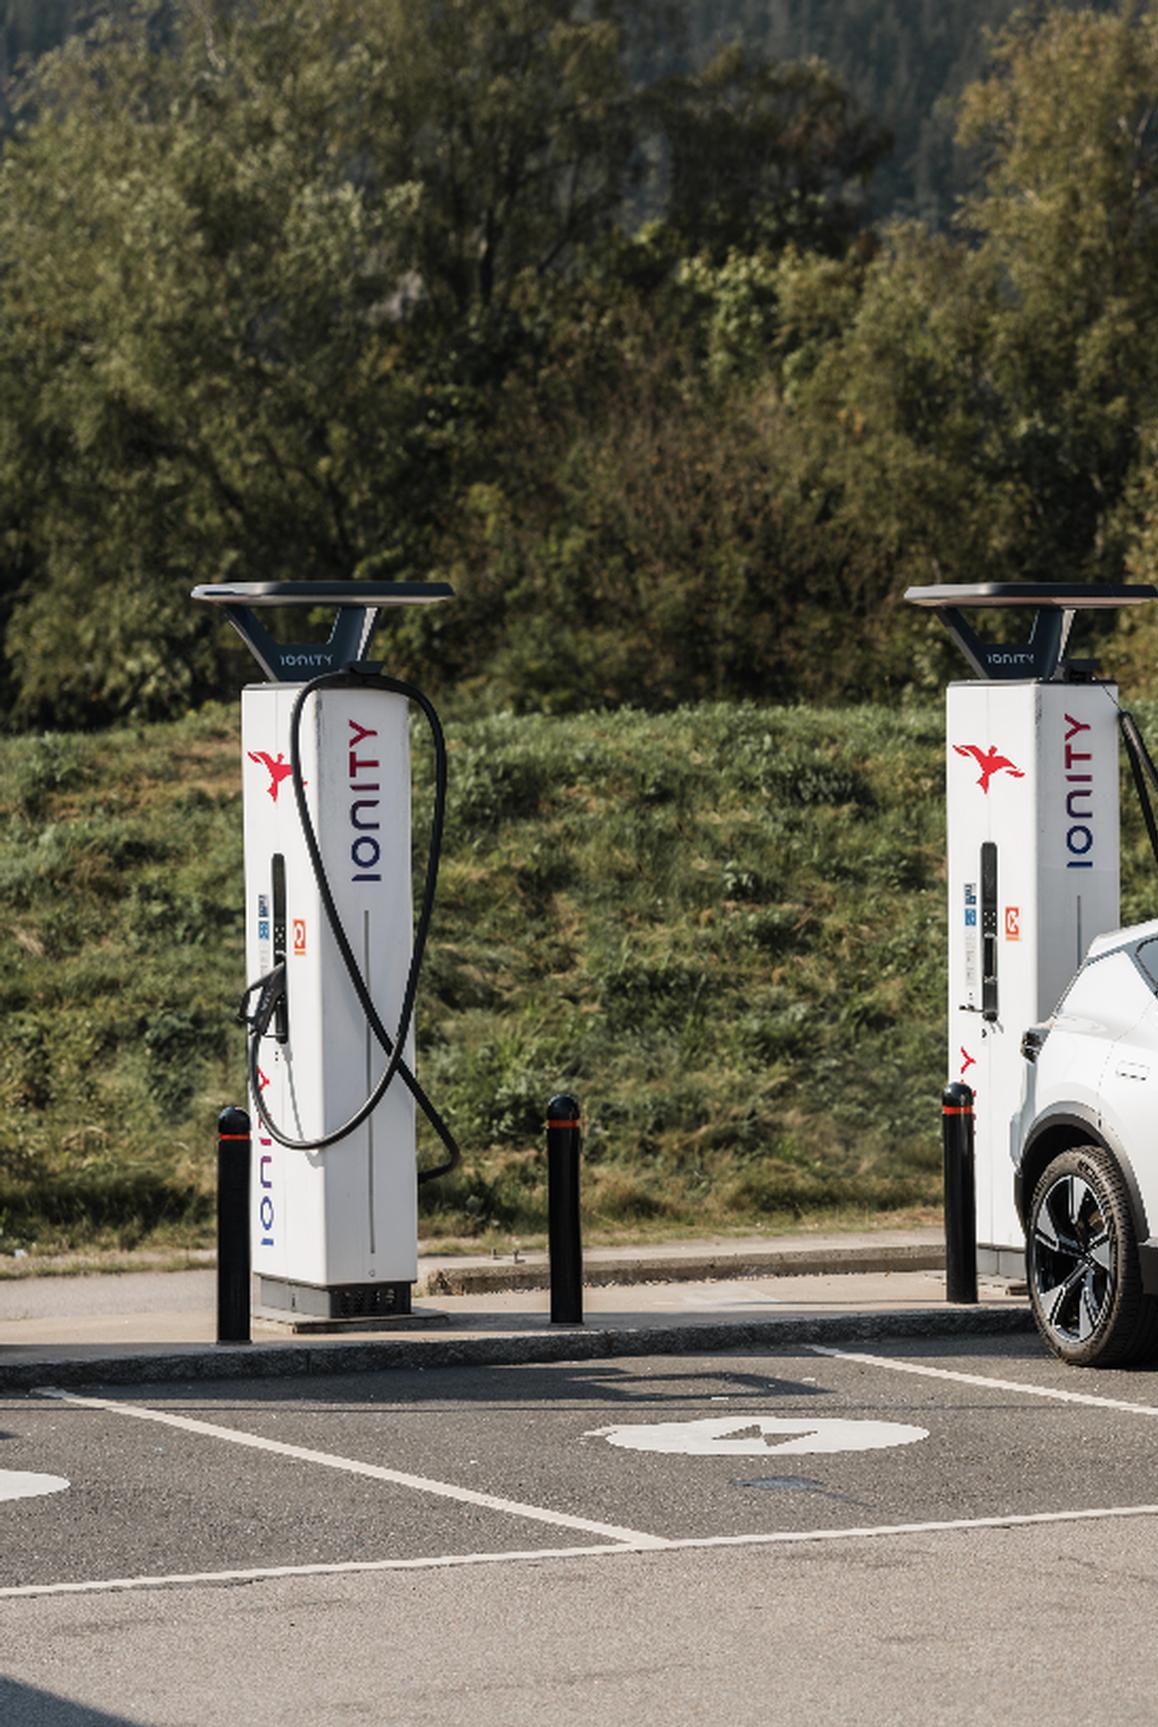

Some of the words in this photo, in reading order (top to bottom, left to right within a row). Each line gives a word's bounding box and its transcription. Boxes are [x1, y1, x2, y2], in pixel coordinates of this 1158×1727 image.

[279, 653, 334, 667] IONITY
[986, 652, 1034, 665] IONITY
[348, 718, 382, 883] IONITY
[1063, 712, 1094, 869] IONITY
